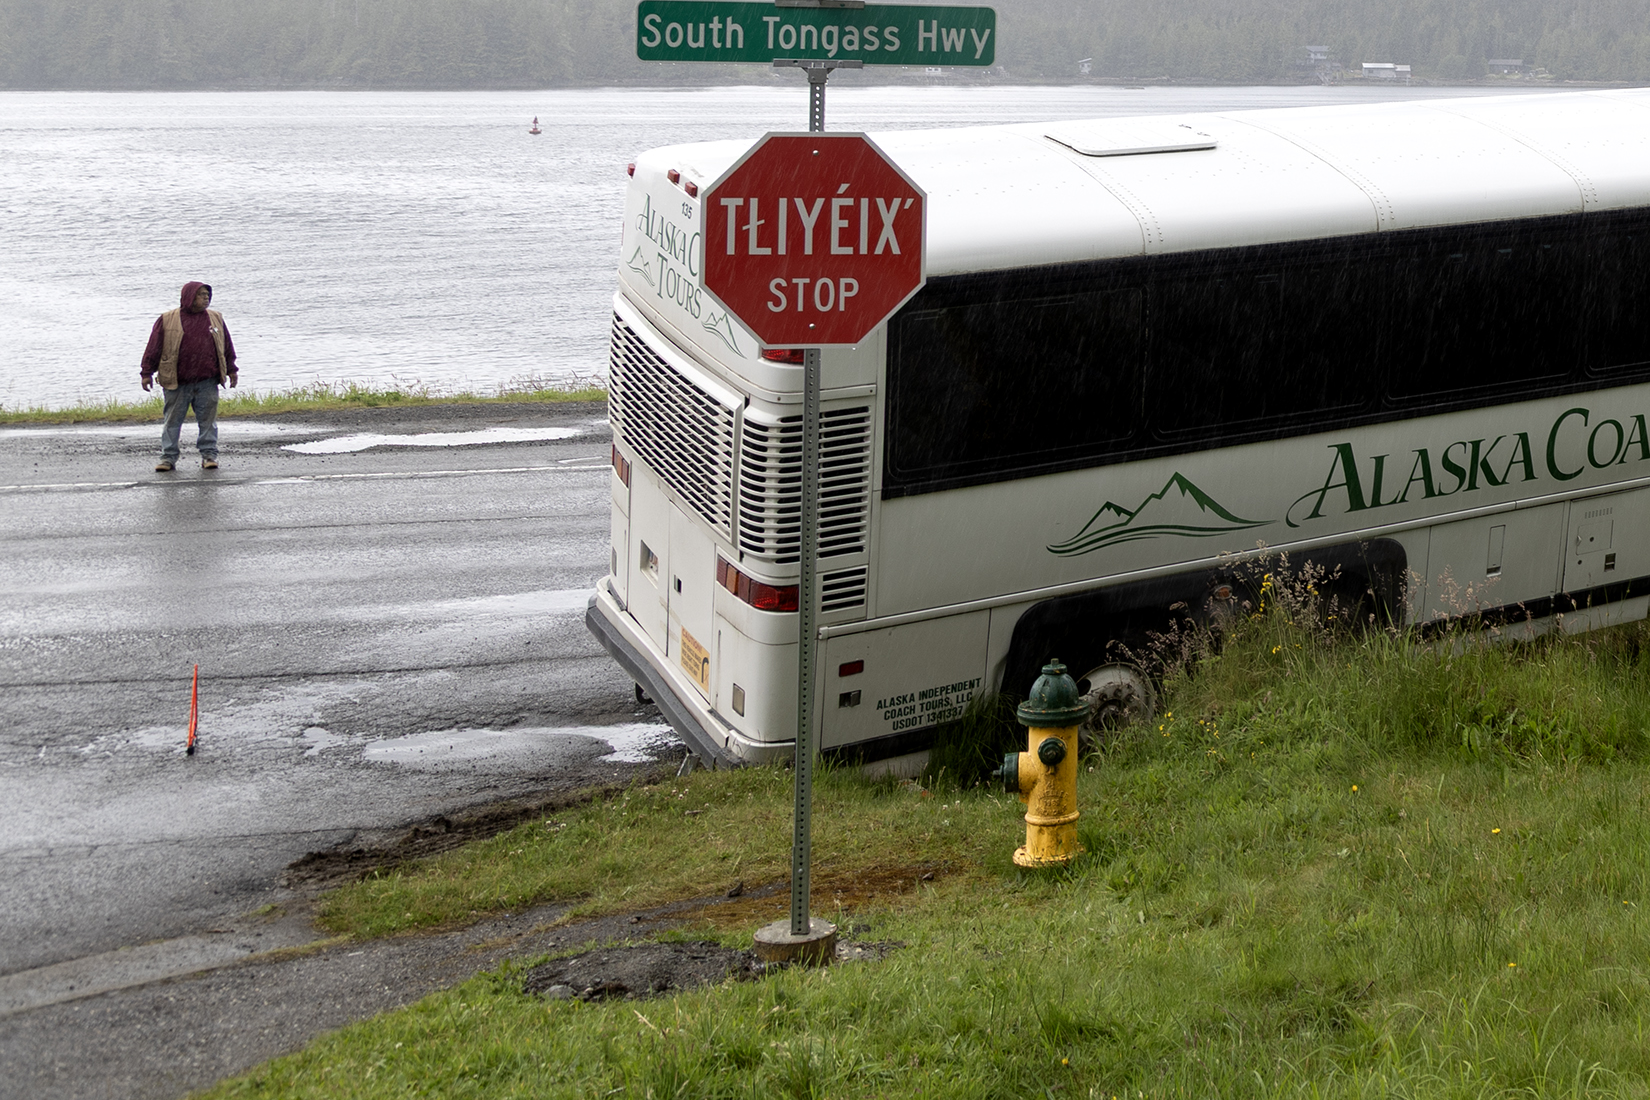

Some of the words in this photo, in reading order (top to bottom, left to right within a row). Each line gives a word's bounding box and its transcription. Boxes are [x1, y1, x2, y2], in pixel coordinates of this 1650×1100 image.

[642, 14, 744, 49] South
[762, 16, 900, 58] Tongass
[918, 19, 991, 59] Hwy
[681, 201, 693, 220] 135
[635, 193, 687, 266] ALASKA
[656, 252, 702, 319] TOURS
[767, 277, 860, 313] STOP
[1285, 432, 1539, 528] ALASKA
[876, 692, 915, 710] ALASKA
[918, 677, 982, 700] INDEPENDENT
[883, 704, 916, 721] COACH
[955, 691, 973, 704] LLC
[892, 715, 924, 731] USDOT
[926, 706, 963, 723] 1341337
